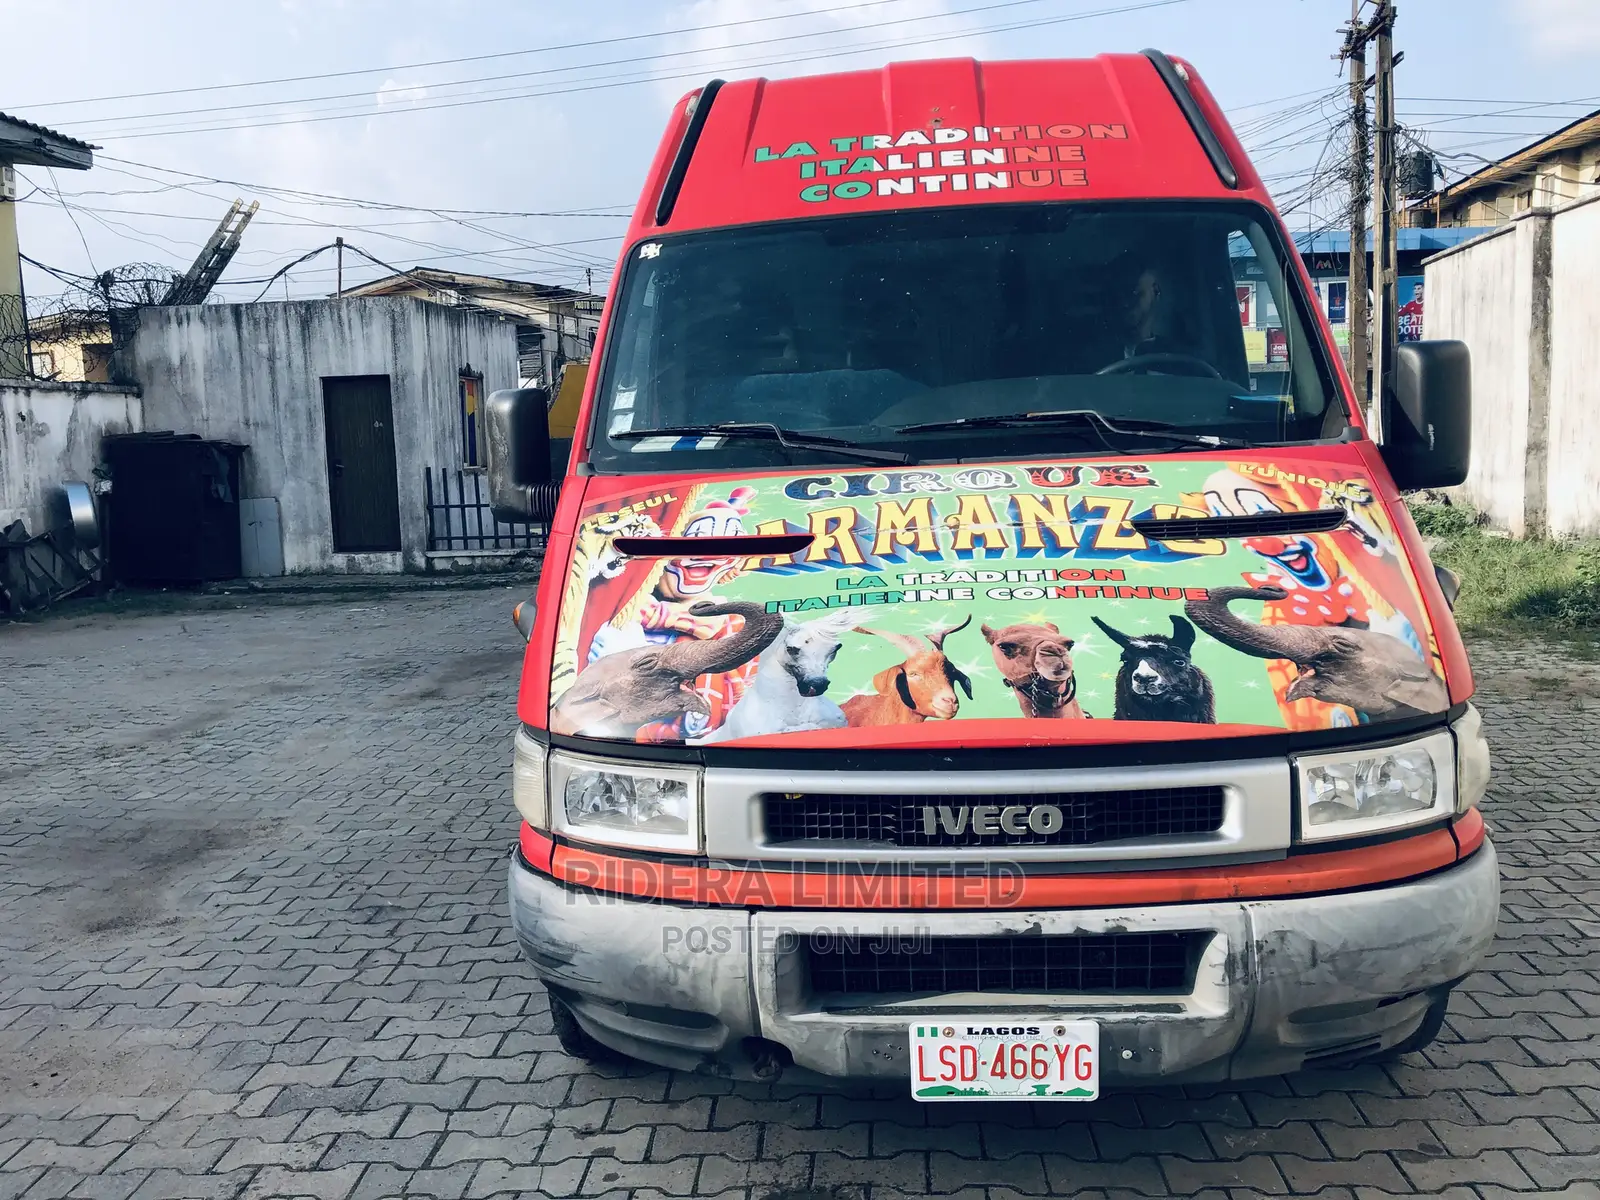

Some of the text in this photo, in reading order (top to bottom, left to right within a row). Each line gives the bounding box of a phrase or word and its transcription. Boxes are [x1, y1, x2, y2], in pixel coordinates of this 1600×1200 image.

[754, 123, 1129, 163] LA TRADITION
[800, 145, 1086, 179] ITALIENNE
[799, 168, 1089, 203] CONTINUE
[591, 301, 604, 309] STUD
[784, 465, 1160, 500] CIRQUE
[1239, 464, 1361, 498] L'UNIQUE
[618, 493, 678, 520] SEUL
[836, 568, 1126, 590] LA TRADITION
[765, 585, 1210, 614] ITALIENNE CONTINUE
[922, 804, 1064, 836] IVECO
[966, 1027, 1040, 1036] LAGOS
